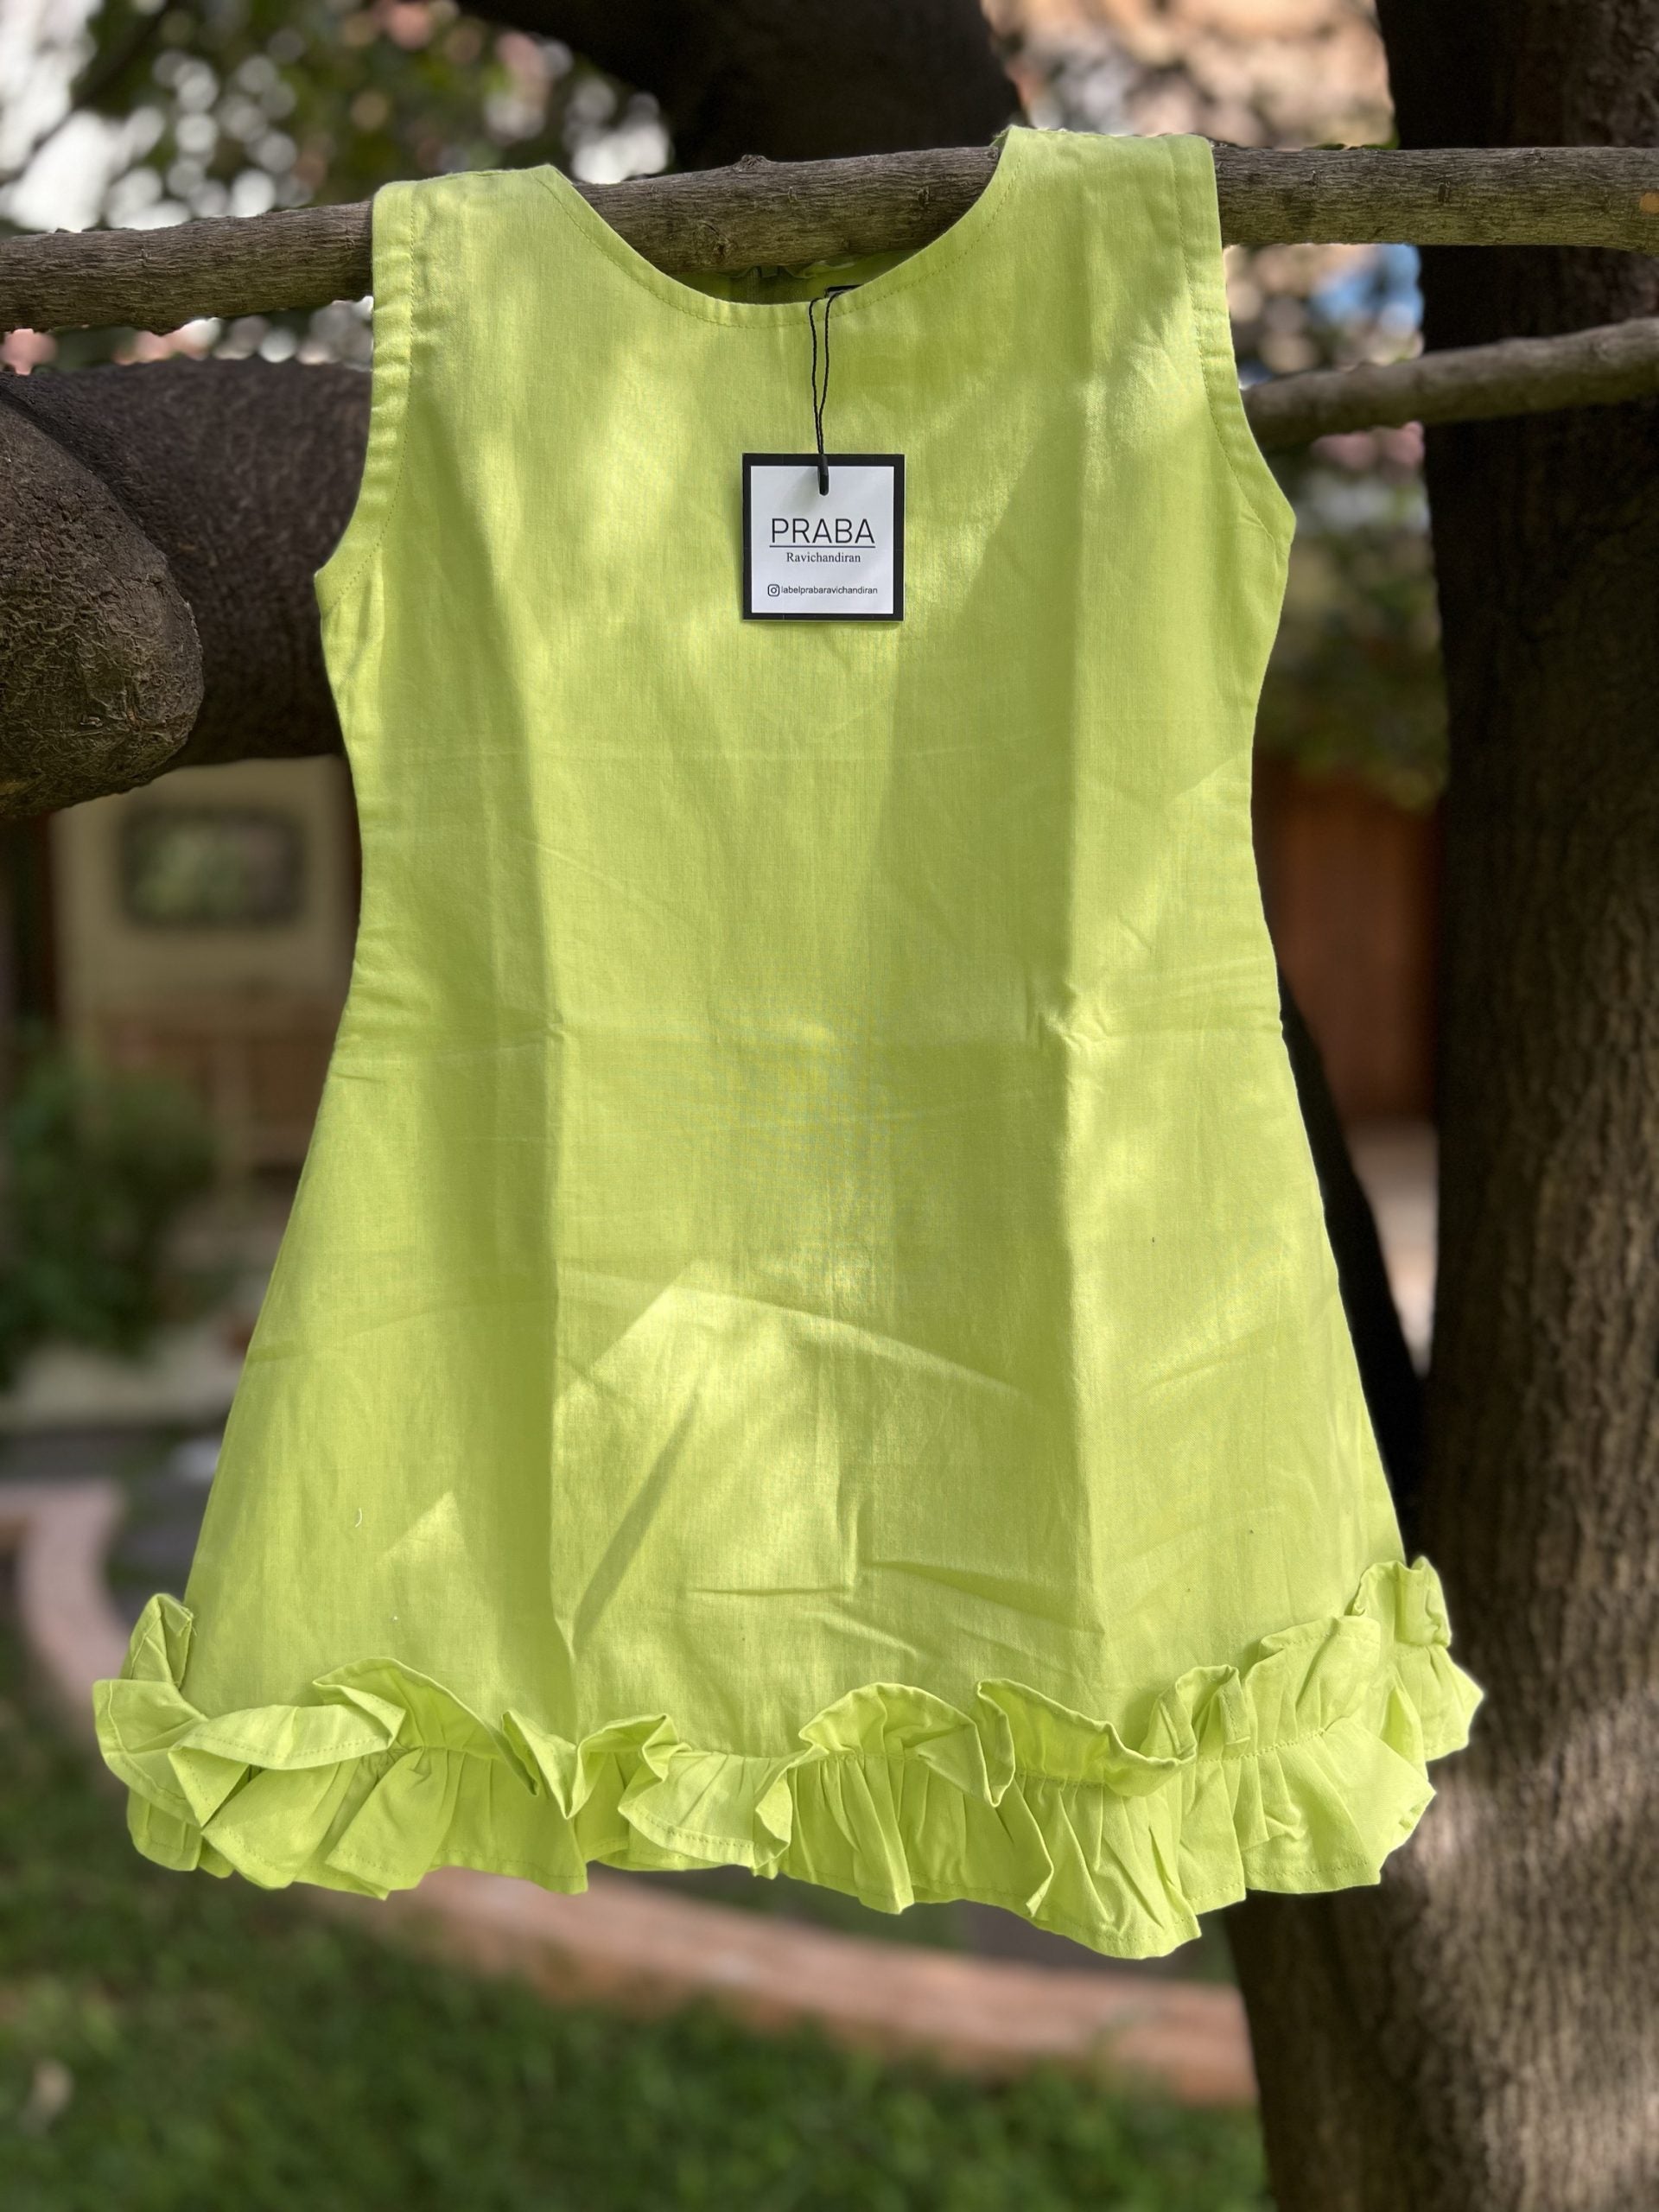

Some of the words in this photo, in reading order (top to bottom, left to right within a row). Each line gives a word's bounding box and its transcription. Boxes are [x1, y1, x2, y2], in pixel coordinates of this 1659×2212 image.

[772, 518, 875, 544] PRABA
[786, 552, 861, 563] Ravichandiran
[780, 586, 878, 595] labelprabaravichandiran
